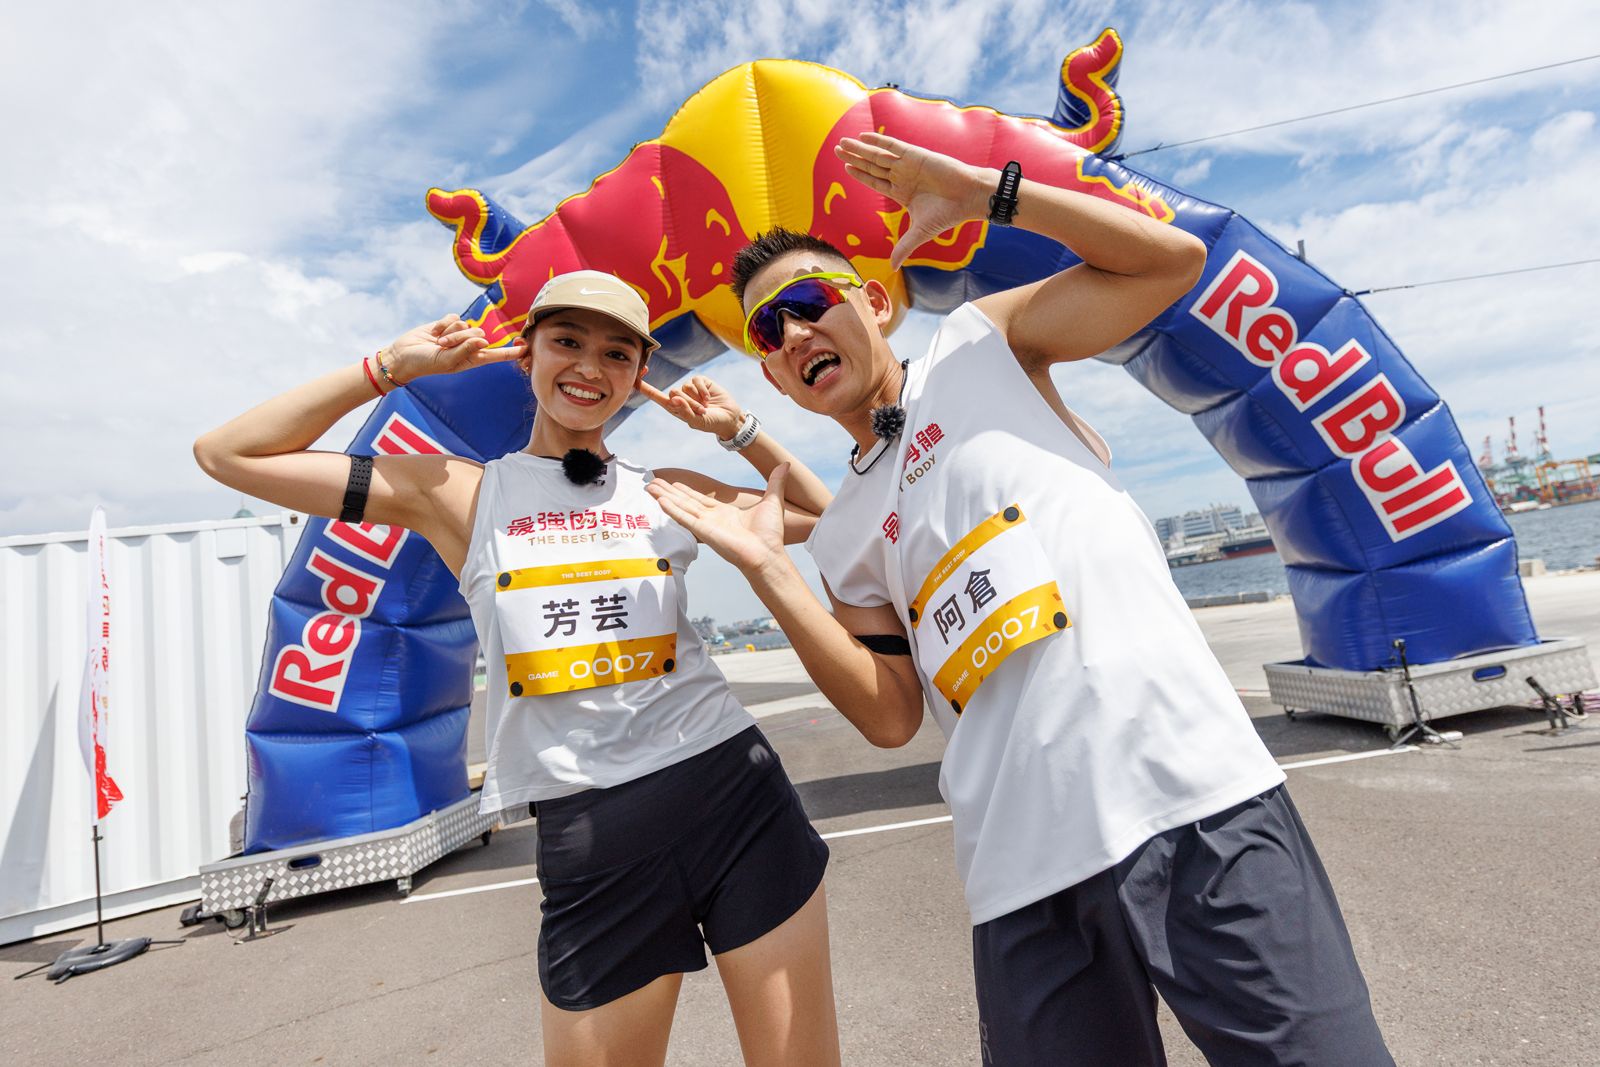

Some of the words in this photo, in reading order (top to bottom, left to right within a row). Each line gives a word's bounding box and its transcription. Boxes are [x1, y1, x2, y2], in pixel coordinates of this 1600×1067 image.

[1194, 253, 1367, 409] Red
[1316, 376, 1470, 538] Bull
[905, 453, 937, 485] BODY
[507, 509, 652, 537] 最強的身體
[528, 535, 556, 546] THE
[561, 533, 597, 544] BEST
[542, 594, 629, 638] 芳芸
[933, 569, 997, 645] 阿倉
[270, 550, 382, 709] Red
[952, 668, 970, 692] GAME
[972, 605, 1040, 668] 0007
[528, 670, 560, 681] GAME
[569, 651, 655, 679] 0007
